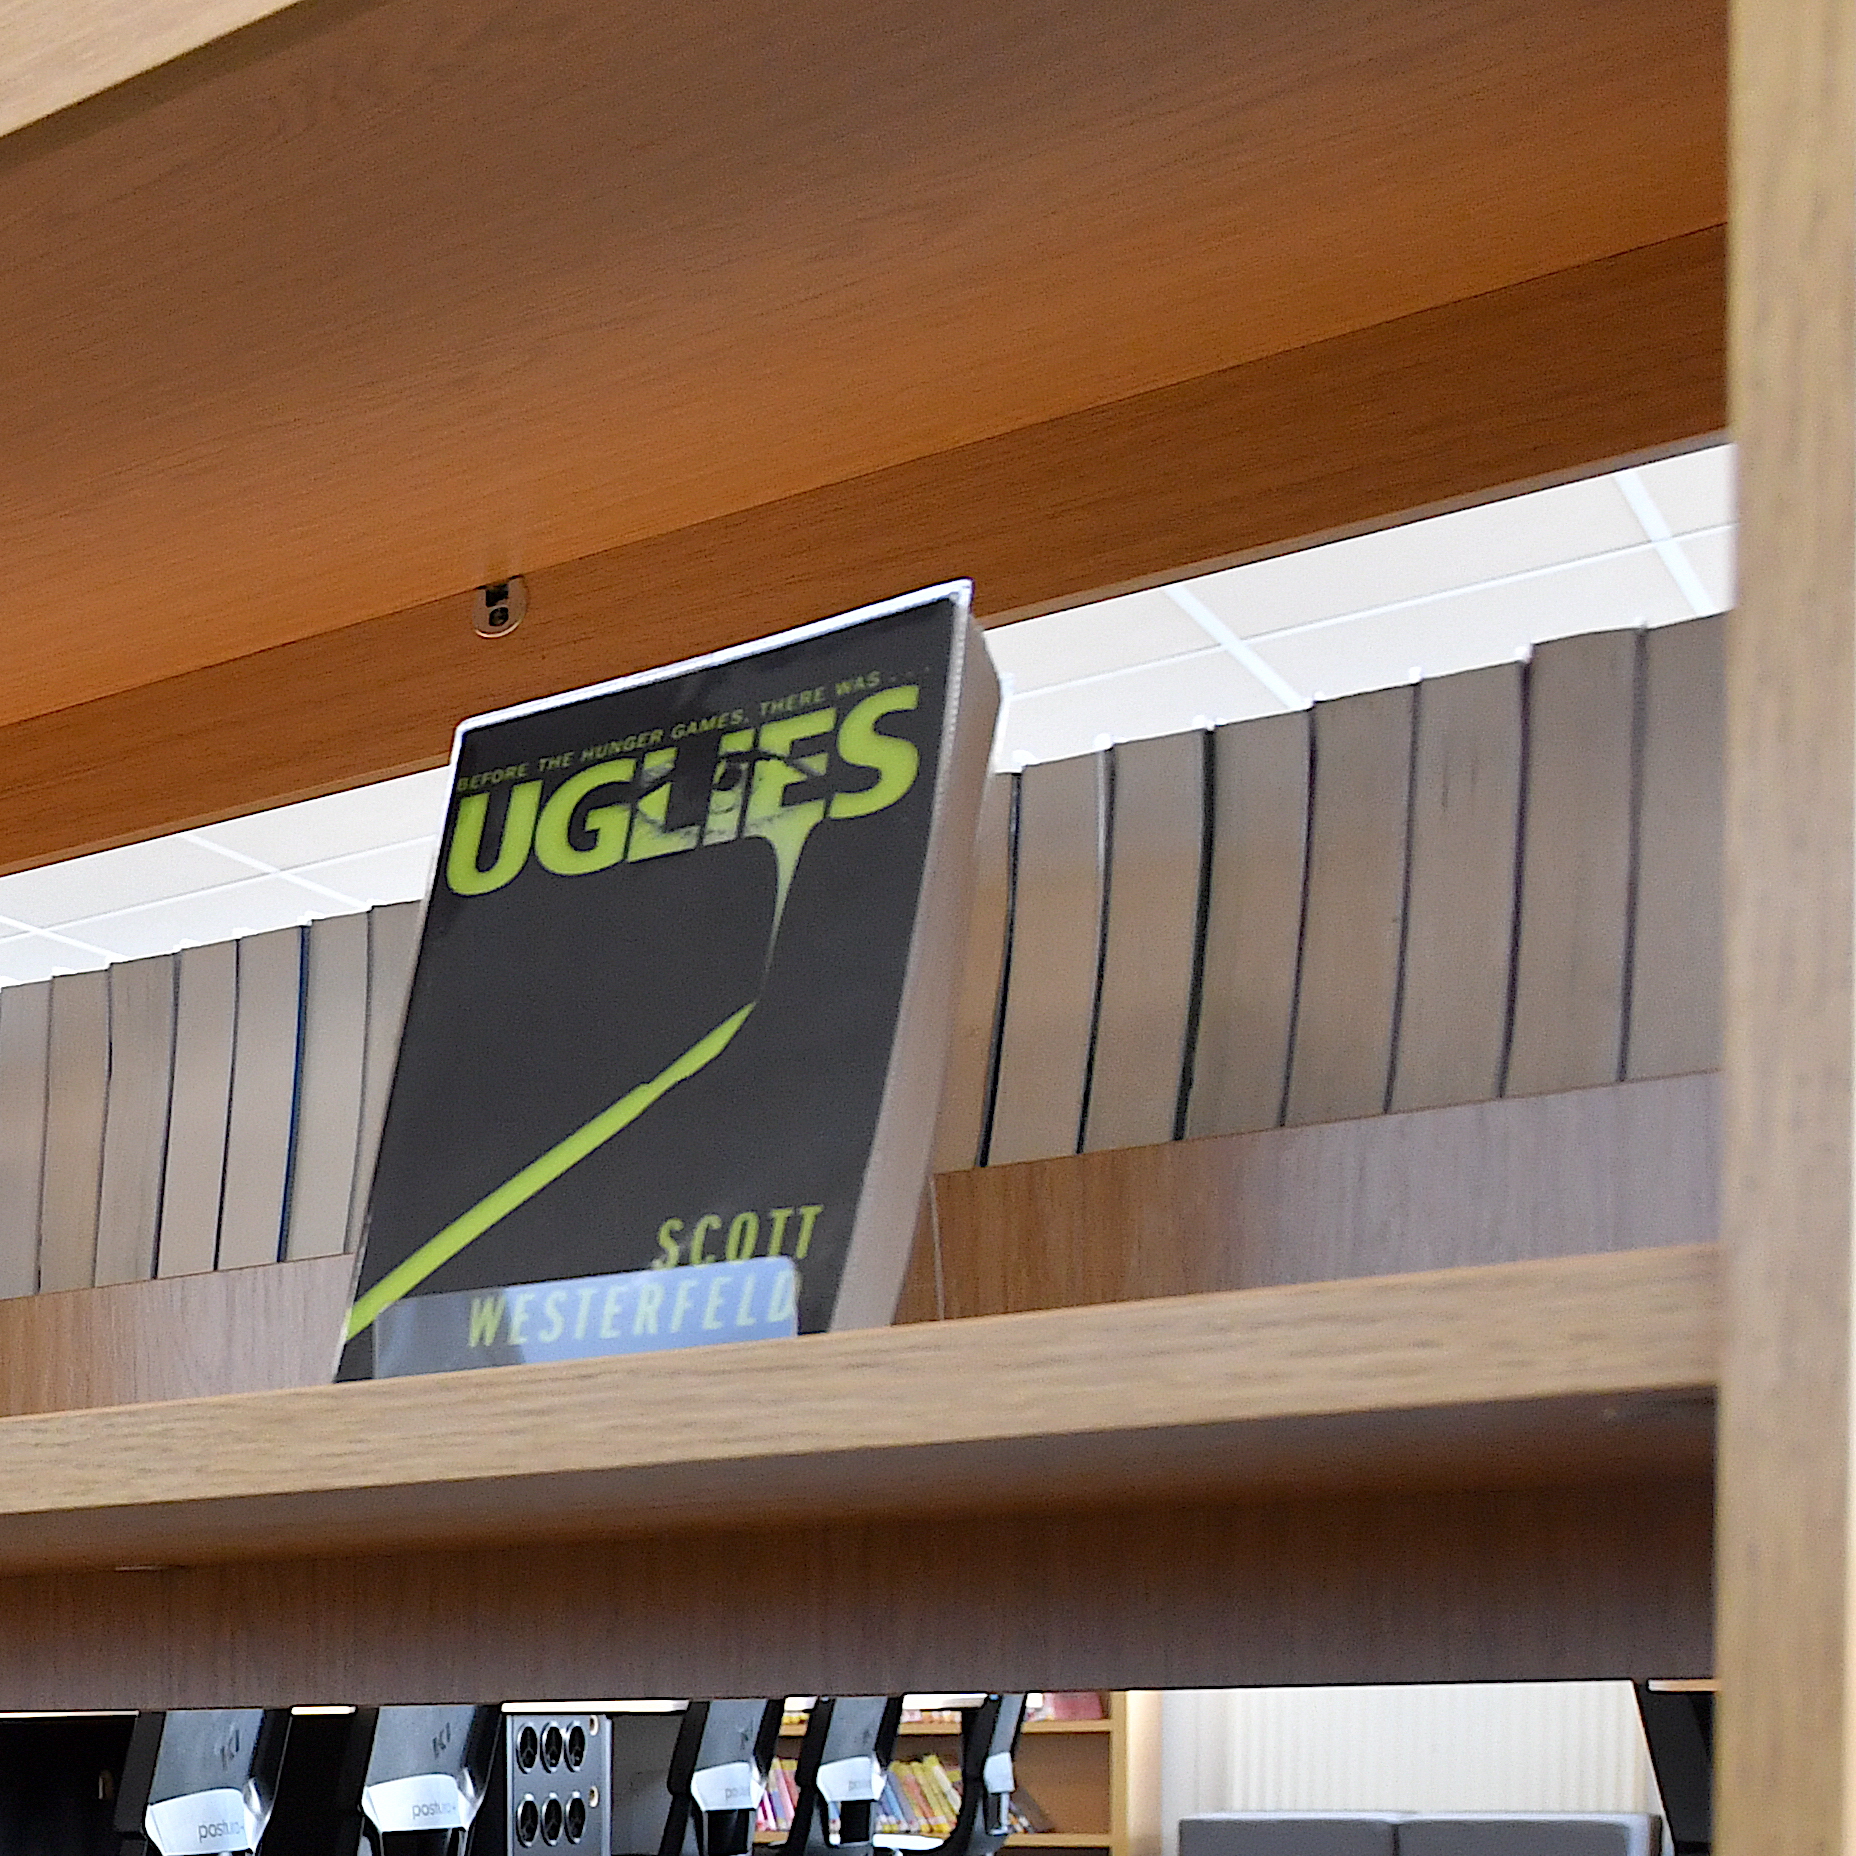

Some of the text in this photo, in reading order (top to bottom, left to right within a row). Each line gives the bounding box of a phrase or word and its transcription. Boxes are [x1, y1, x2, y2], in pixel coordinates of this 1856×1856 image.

[457, 762, 530, 793] BEFORE
[538, 751, 575, 773] THE
[580, 728, 665, 763] HUNGER
[760, 687, 826, 716] THERE
[835, 670, 882, 696] WAS
[446, 684, 921, 897] UGLIES
[651, 1203, 825, 1272] SCOTT
[468, 1269, 803, 1348] WESTERFELD
